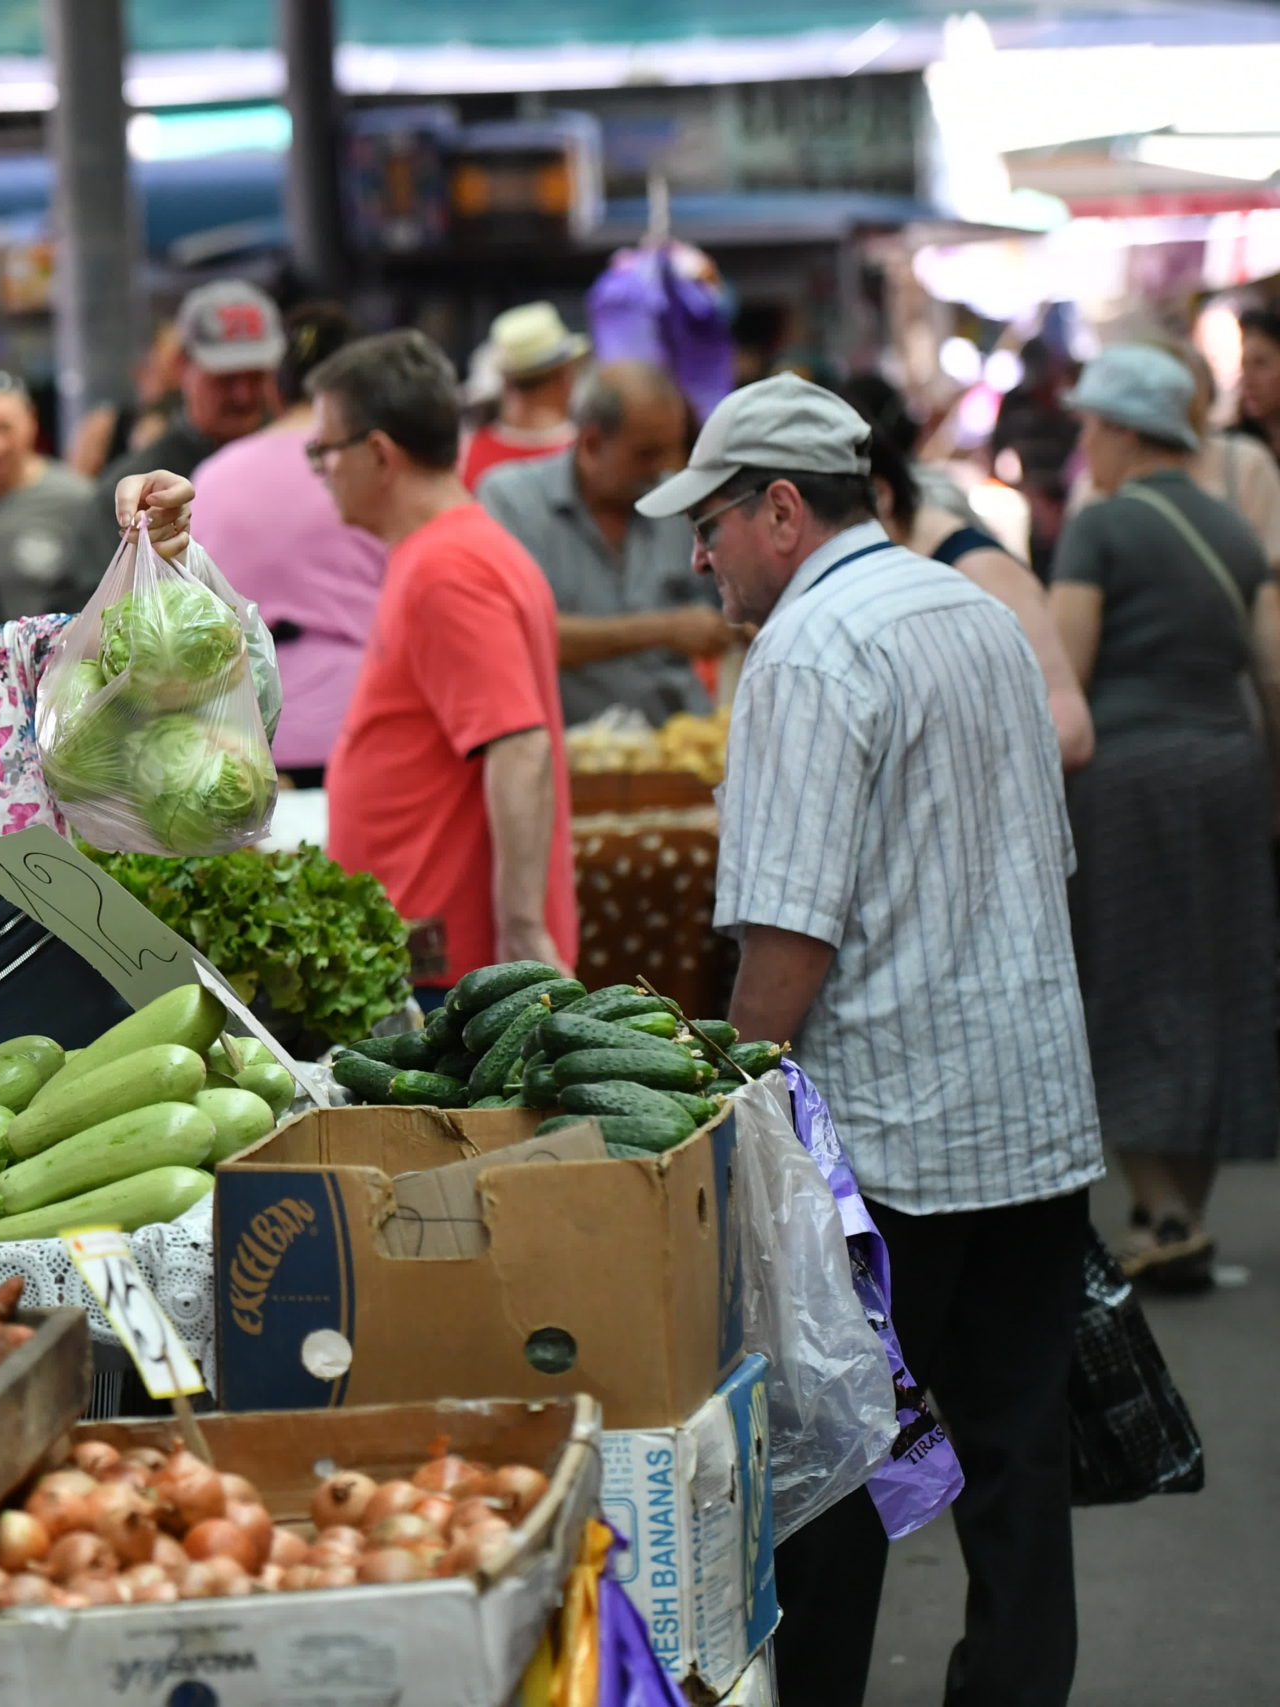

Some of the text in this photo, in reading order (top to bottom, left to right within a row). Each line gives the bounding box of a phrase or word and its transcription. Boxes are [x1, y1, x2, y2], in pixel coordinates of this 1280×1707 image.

[229, 1197, 316, 1336] EXCELBAN
[645, 1448, 680, 1674] RESH BANANAS
